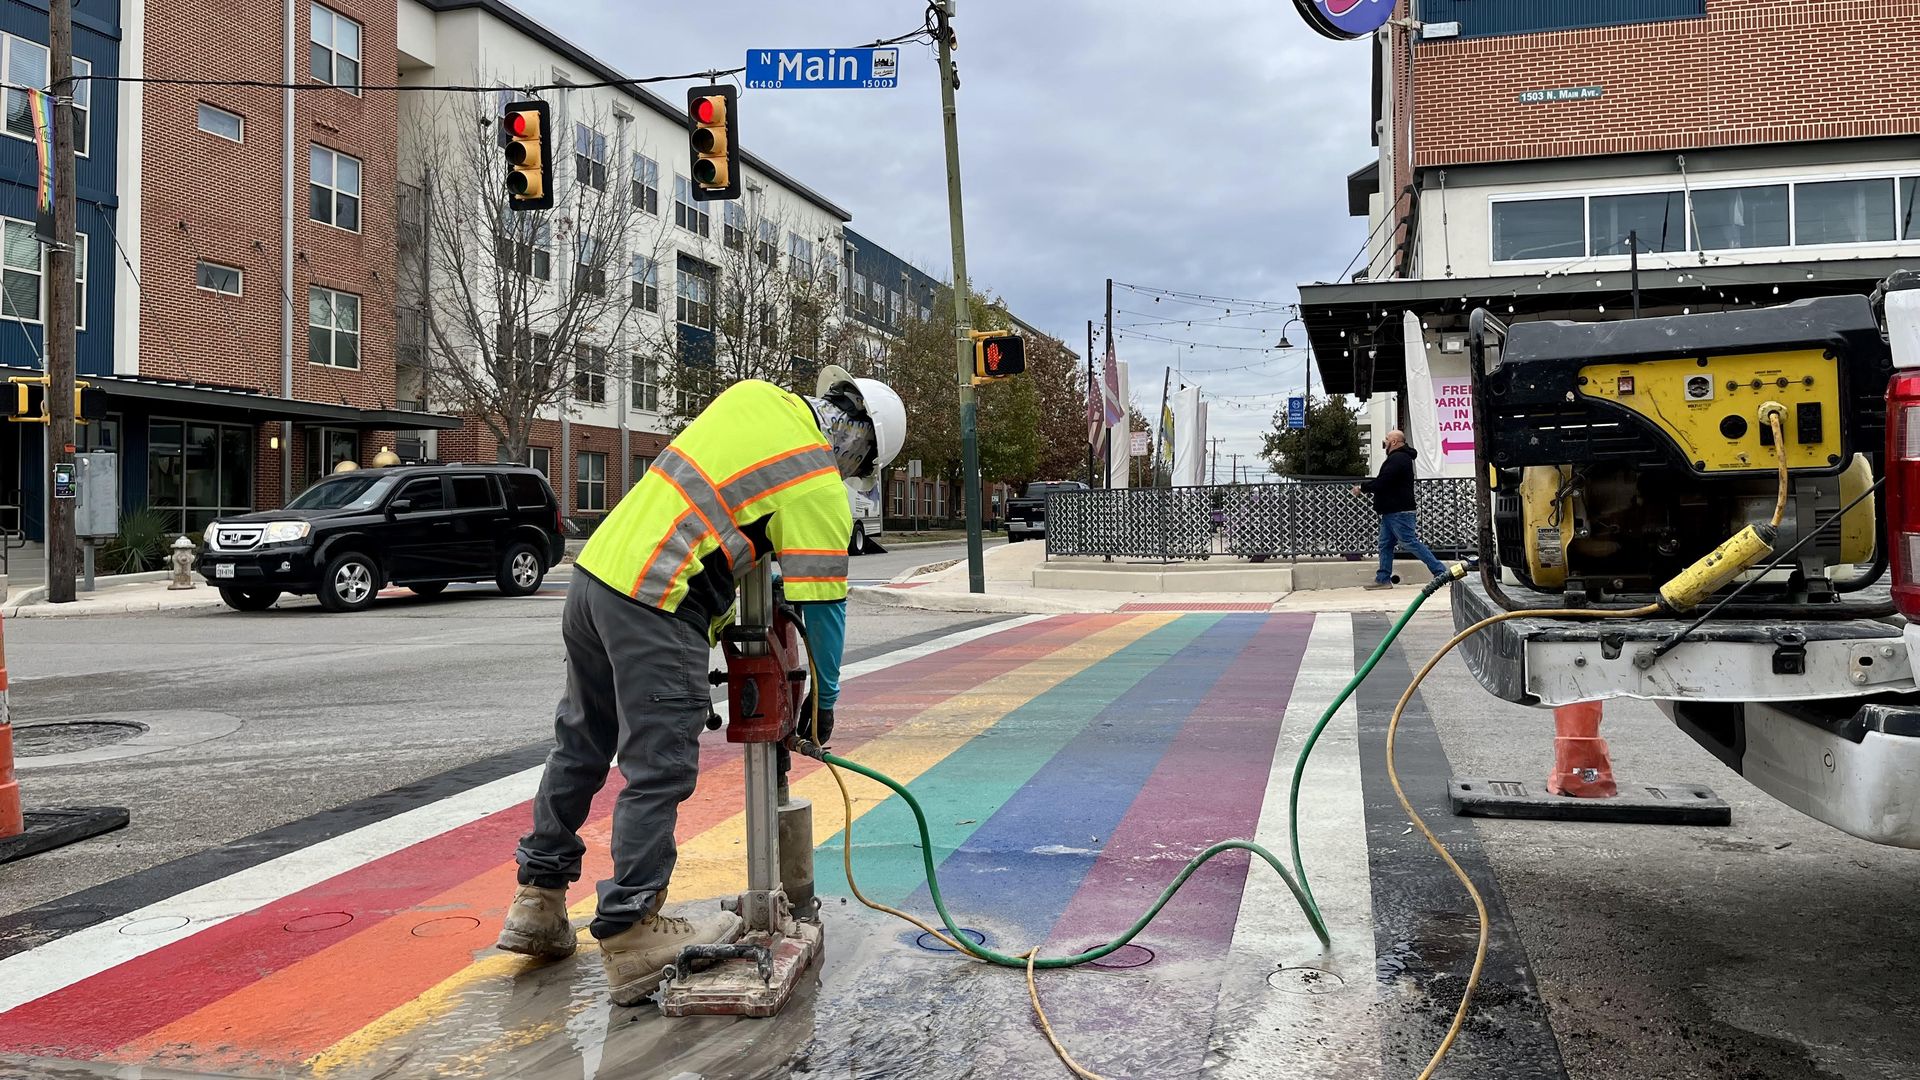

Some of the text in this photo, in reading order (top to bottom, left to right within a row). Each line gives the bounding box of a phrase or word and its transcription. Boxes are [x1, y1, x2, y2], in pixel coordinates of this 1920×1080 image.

[761, 49, 858, 81] N Main
[862, 80, 887, 88] 1500
[1521, 92, 1544, 101] 1503
[1547, 91, 1556, 100] N.
[1454, 409, 1469, 418] IN
